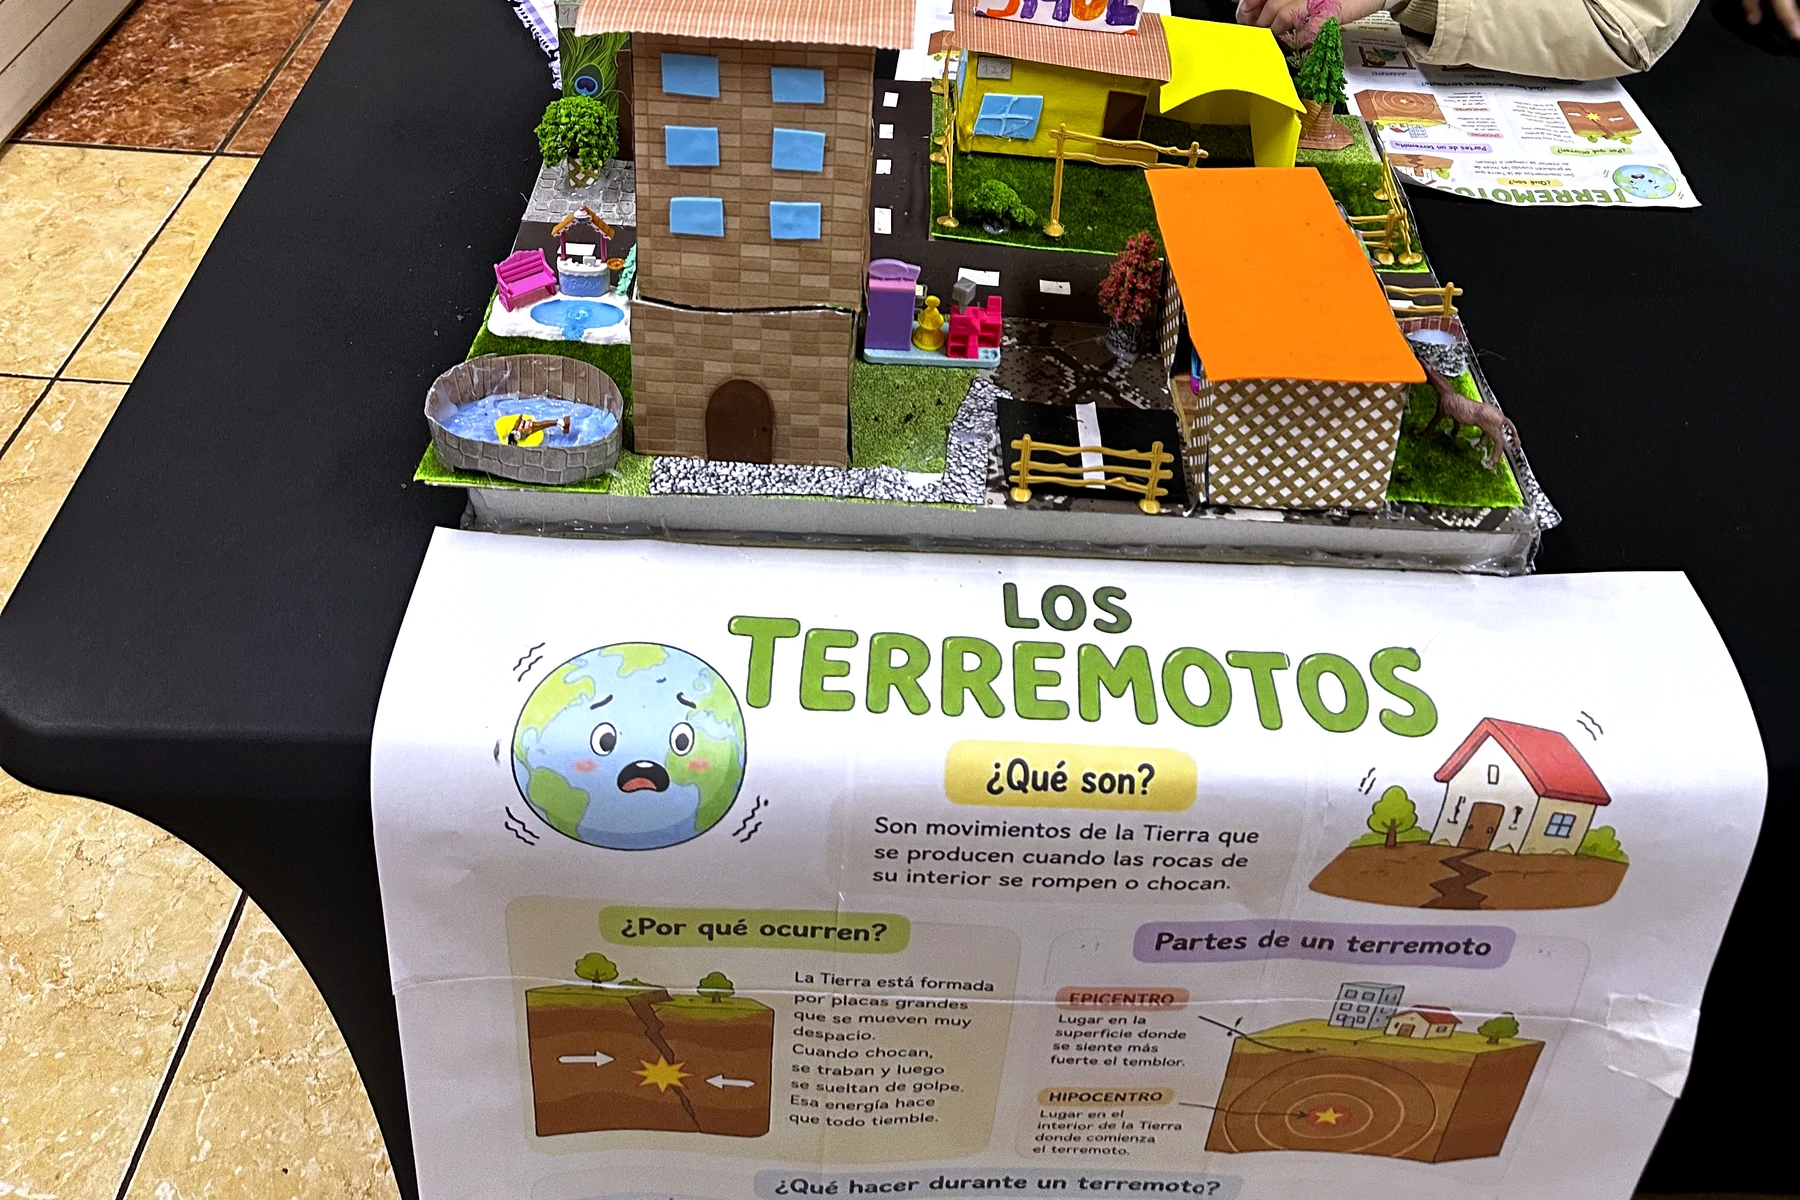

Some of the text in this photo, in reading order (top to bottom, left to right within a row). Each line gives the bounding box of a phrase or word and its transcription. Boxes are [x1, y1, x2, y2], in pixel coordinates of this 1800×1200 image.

[1460, 144, 1488, 152] Partes
[1002, 581, 1133, 633] LOS
[727, 615, 1439, 738] TERREMOTOS
[986, 759, 1156, 797] ¿Qué son?
[874, 816, 1260, 849] Son movimientos de la Tierra que
[874, 846, 1249, 869] se producen cuando las rocas de
[872, 869, 1231, 893] su interior se rompen o chocan.
[620, 916, 888, 944] ¿Por qué ocurren?
[1155, 930, 1492, 958] Partes de un terremoto
[795, 971, 994, 992] La Tierra está formada
[794, 994, 968, 1010] por placas grandes
[1069, 992, 1175, 1006] EPICENTRO
[793, 1011, 972, 1029] que se mueven muy
[1058, 1014, 1146, 1026] Lugar en la
[793, 1026, 876, 1042] despacio.
[1055, 1028, 1187, 1040] superficie donde
[792, 1043, 933, 1059] Cuando chocan,
[1052, 1042, 1159, 1053] se siente más
[1050, 1055, 1185, 1067] fuerte el temblor.
[791, 1063, 945, 1078] se traban y luego
[791, 1080, 964, 1094] se sueltan de golpe.
[790, 1095, 935, 1113] Esa energía hace
[1049, 1092, 1163, 1102] HIPOCENTRO
[789, 1112, 938, 1127] que todo tiemble.
[1040, 1110, 1124, 1120] Lugar en el
[1037, 1120, 1182, 1131] interior de la Tierra
[1034, 1132, 1155, 1143] donde comienza
[1032, 1144, 1130, 1156] el terremoto.
[775, 1174, 1221, 1197] ¿Qué hacer durante un terremoto?
